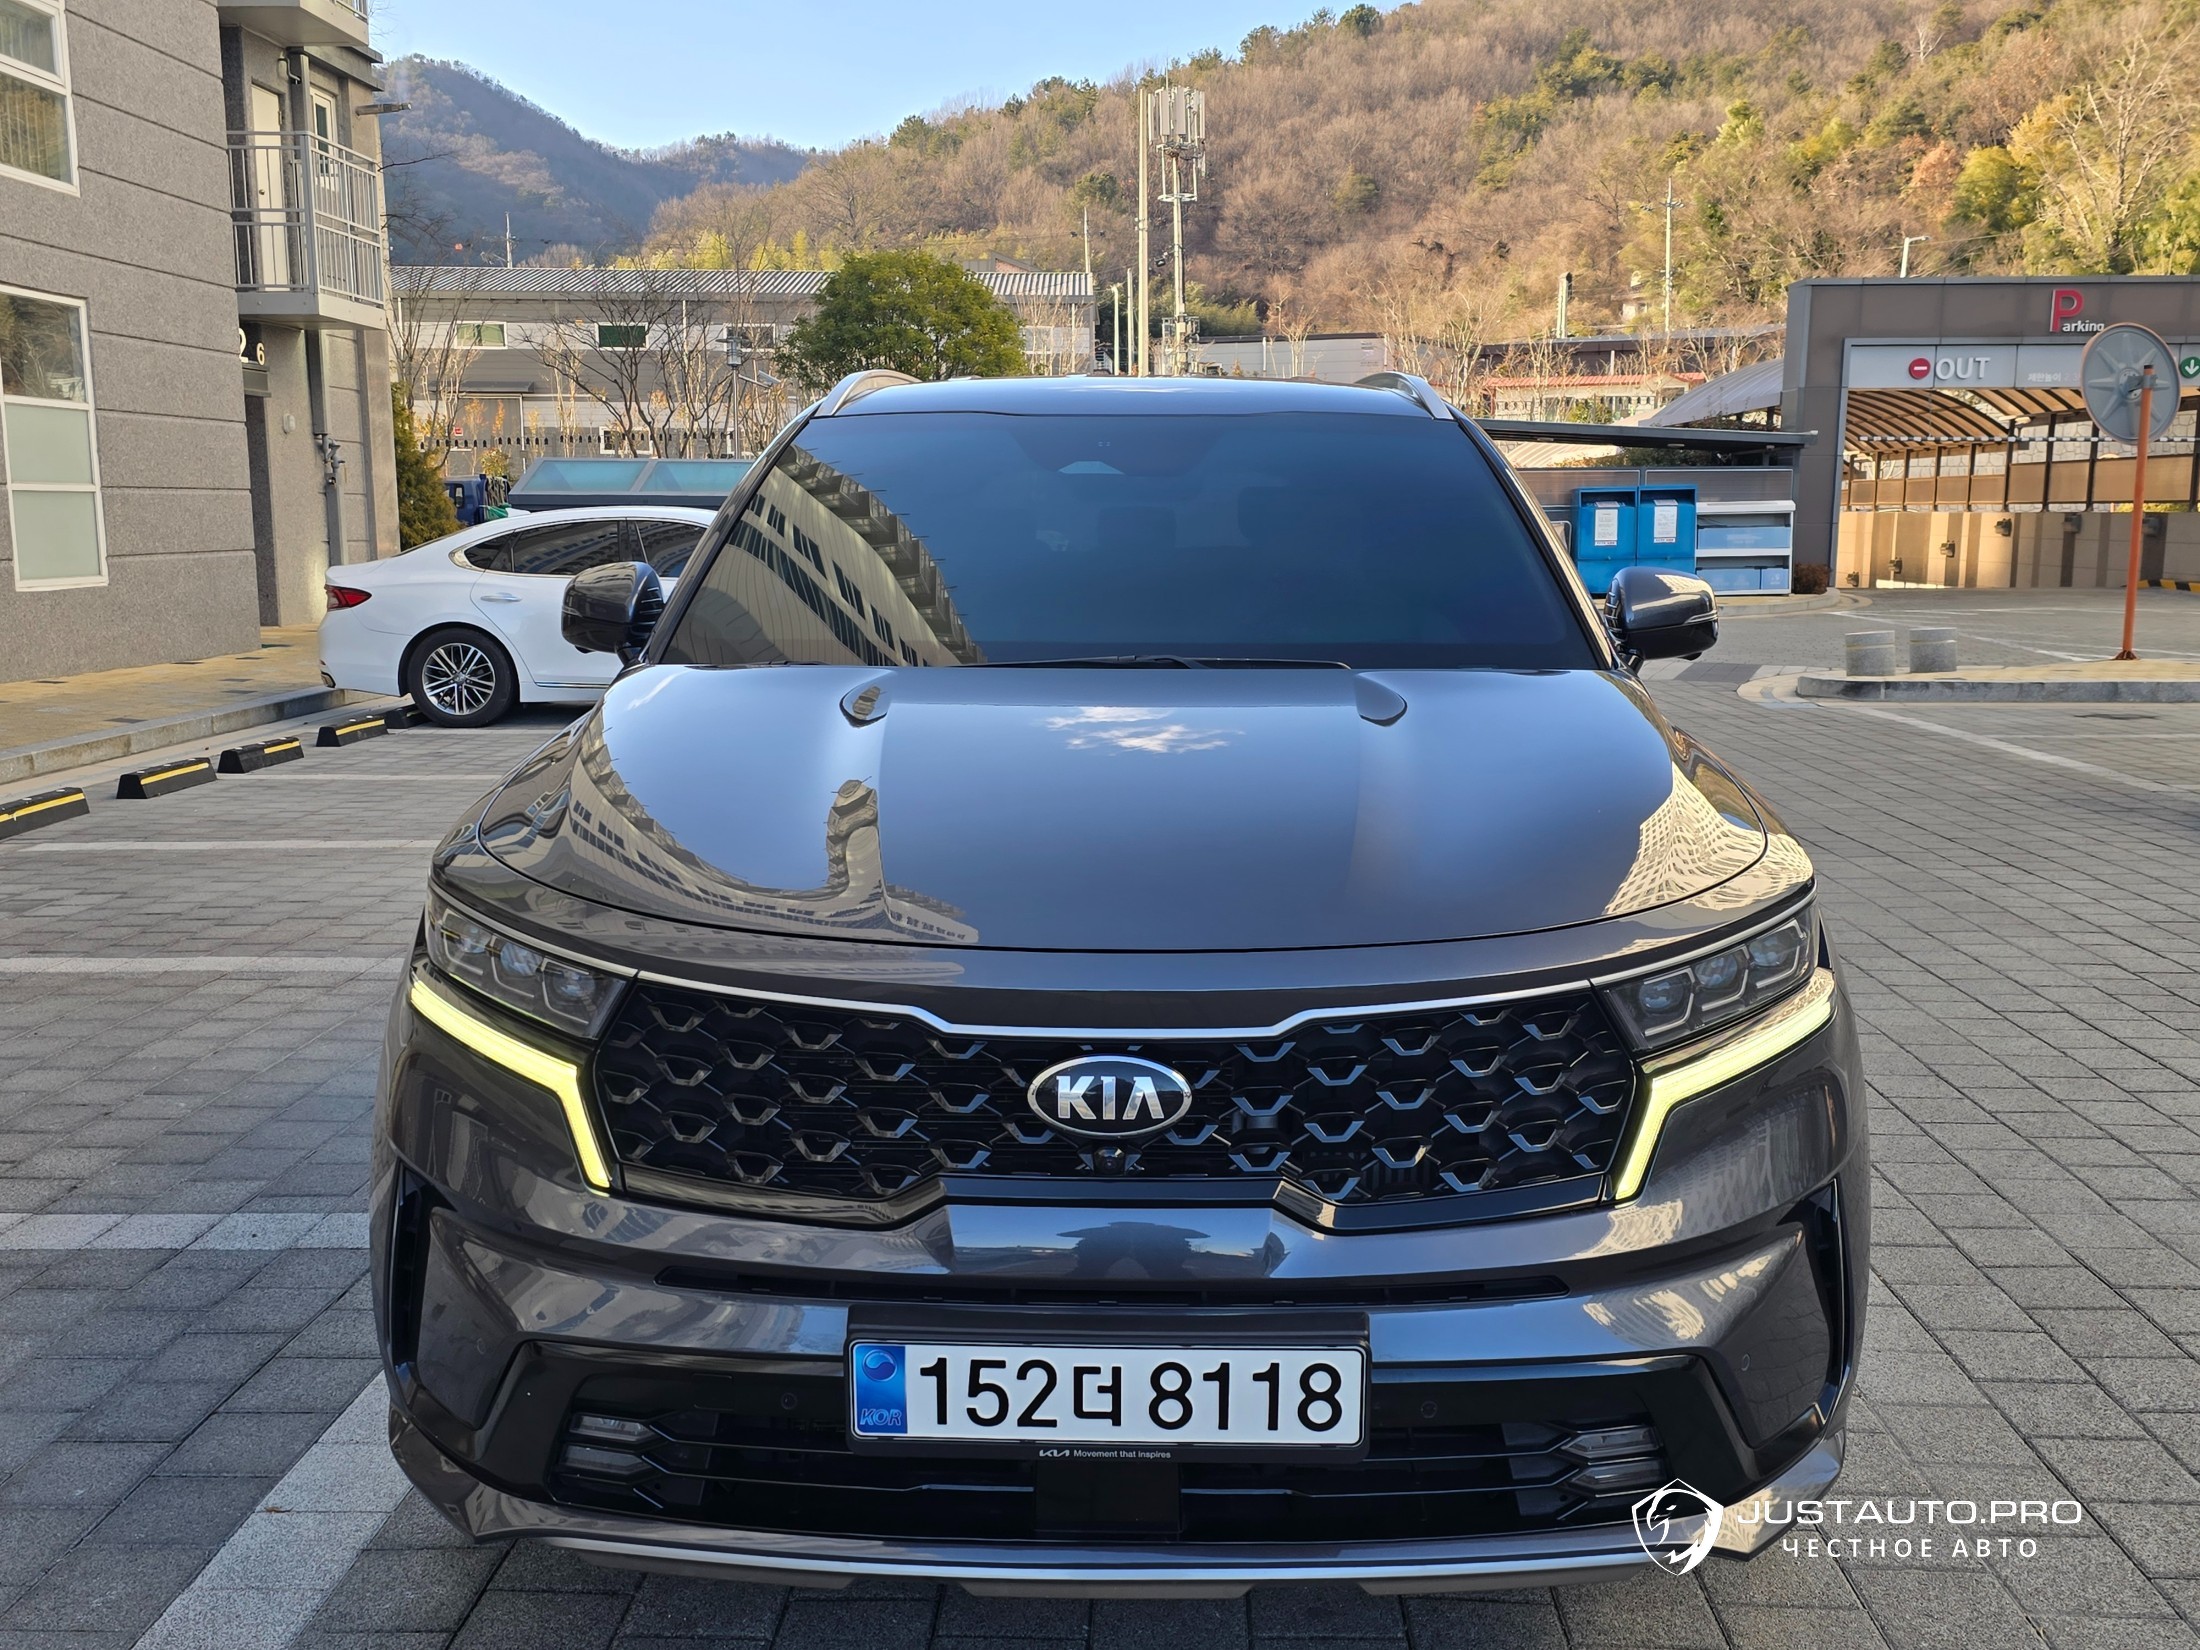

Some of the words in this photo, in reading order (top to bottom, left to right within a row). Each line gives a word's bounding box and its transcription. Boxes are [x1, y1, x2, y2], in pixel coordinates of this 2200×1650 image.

[1936, 357, 1991, 380] OUT
[1056, 1075, 1165, 1120] KIA
[919, 1357, 1122, 1428] 152더
[1148, 1361, 1343, 1432] 8118
[860, 1408, 903, 1426] KOR
[1073, 1449, 1118, 1458] Movement
[1119, 1450, 1136, 1459] that
[1138, 1450, 1172, 1461] inspires
